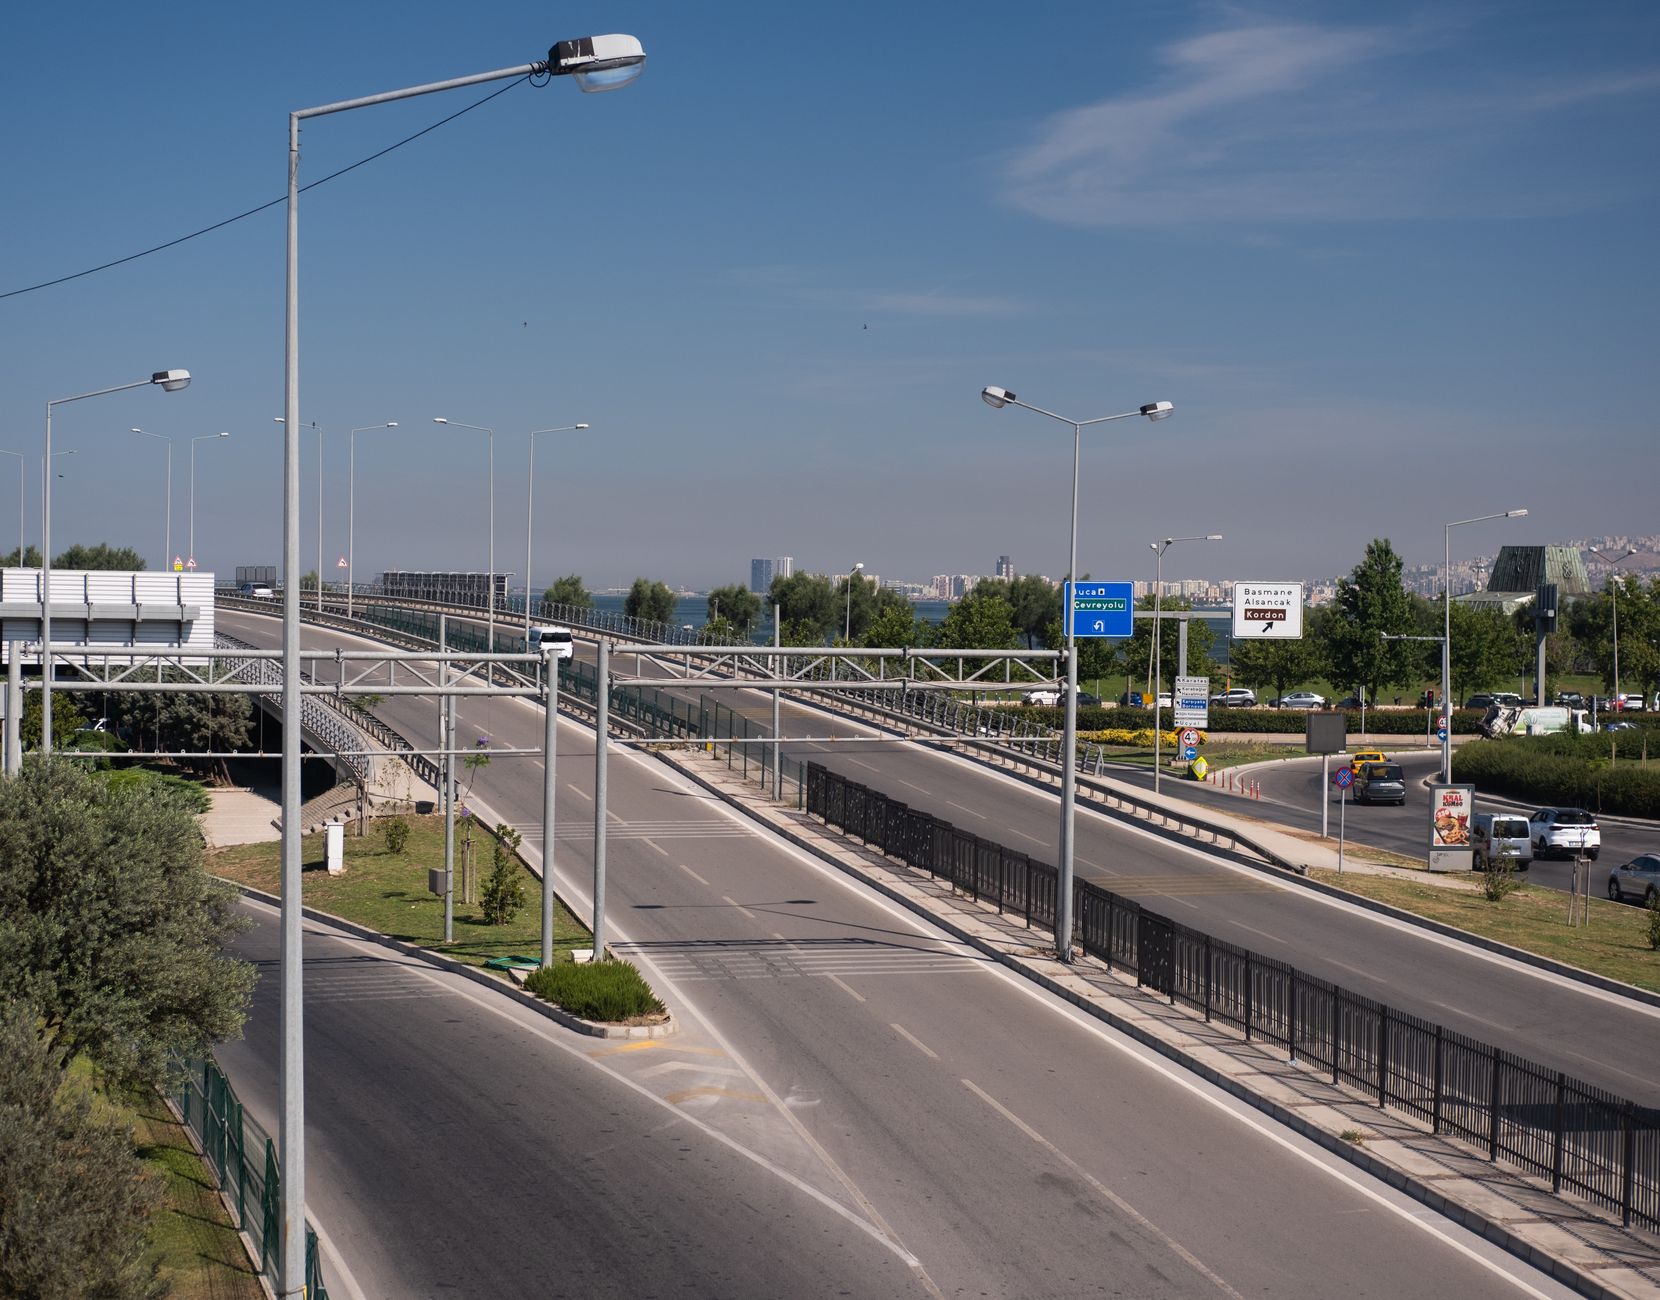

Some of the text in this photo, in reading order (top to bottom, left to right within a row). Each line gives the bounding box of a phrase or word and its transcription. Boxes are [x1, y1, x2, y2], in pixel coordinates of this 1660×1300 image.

[1244, 588, 1293, 596] Basmane
[1074, 601, 1124, 610] Çevreyolu
[1244, 598, 1291, 606] Alsancak
[1246, 611, 1284, 619] Kordon
